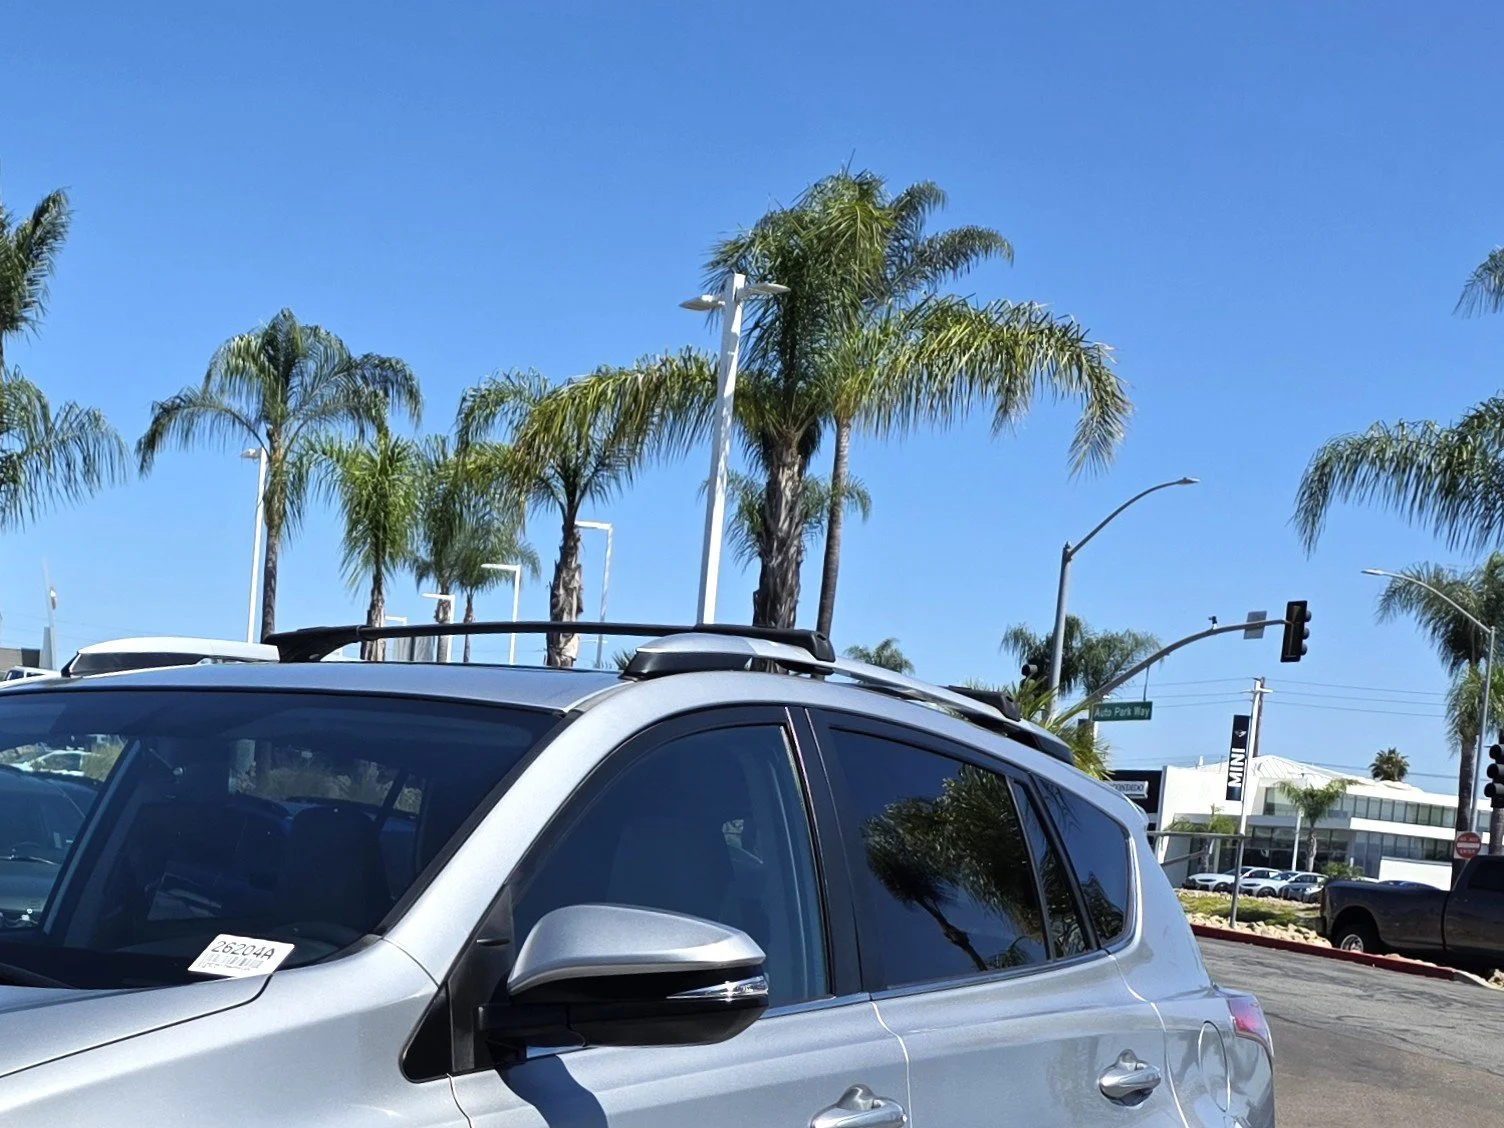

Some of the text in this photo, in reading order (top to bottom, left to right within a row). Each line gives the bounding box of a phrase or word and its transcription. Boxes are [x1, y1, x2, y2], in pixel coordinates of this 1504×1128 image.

[1094, 705, 1150, 718] Auto Park Way
[1228, 747, 1246, 788] MINI
[211, 940, 275, 960] 26204A
